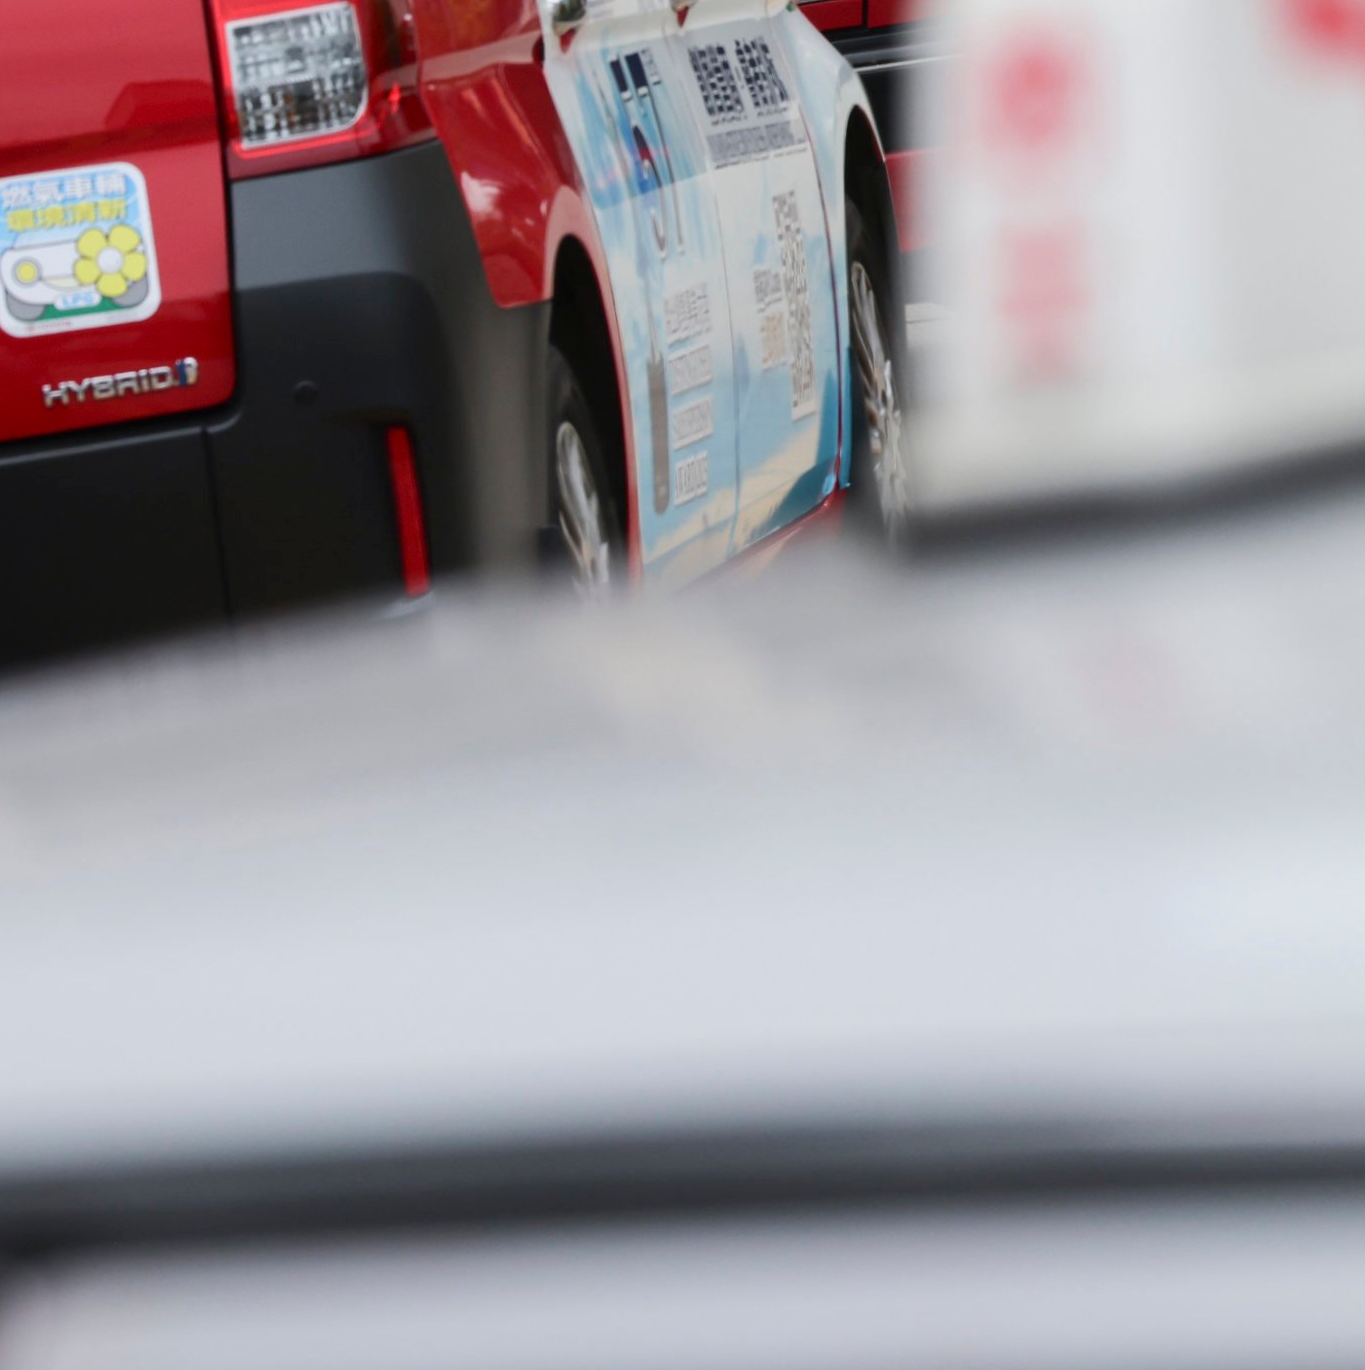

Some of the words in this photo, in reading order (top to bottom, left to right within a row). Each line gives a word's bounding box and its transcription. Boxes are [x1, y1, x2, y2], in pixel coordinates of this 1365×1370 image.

[1, 174, 128, 209] 燃氣車輛
[6, 198, 128, 233] 環境清新
[43, 365, 173, 407] HYBRID
